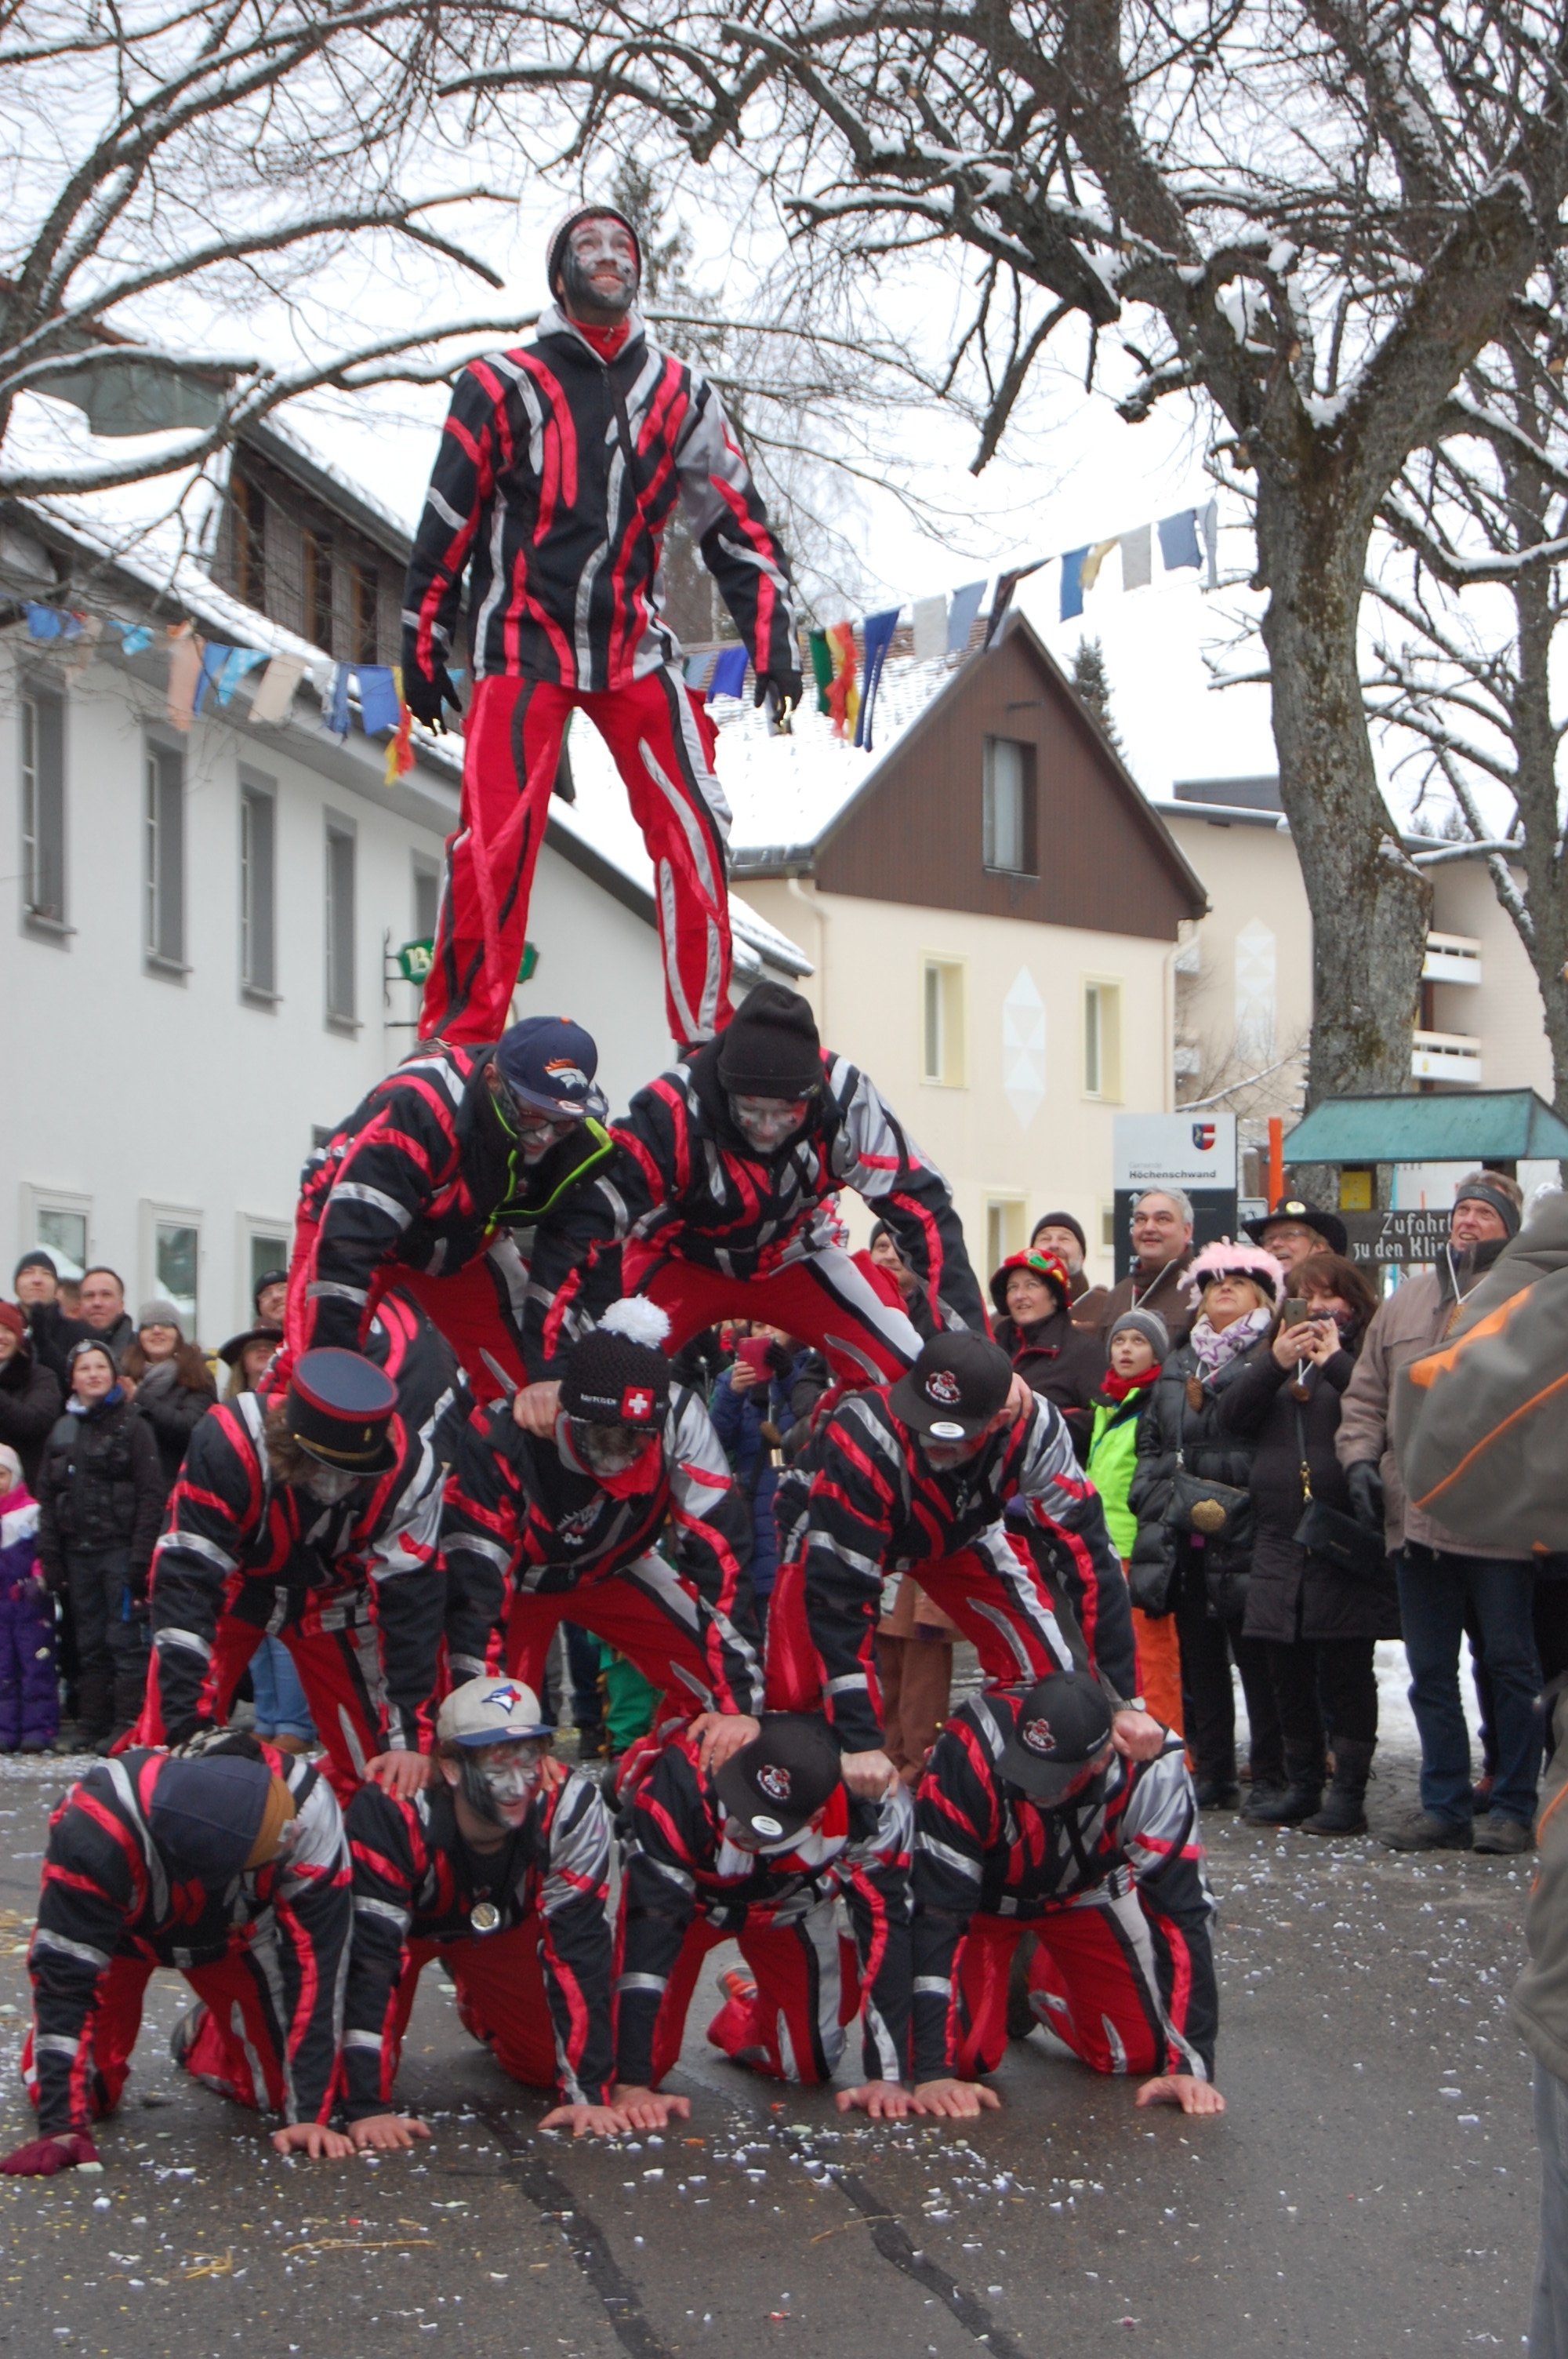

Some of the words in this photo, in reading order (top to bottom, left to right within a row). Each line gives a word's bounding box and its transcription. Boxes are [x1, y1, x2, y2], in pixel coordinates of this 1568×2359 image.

[1130, 1169, 1217, 1179] Höchenschwand
[1352, 1243, 1370, 1261] zu
[1375, 1237, 1403, 1257] den
